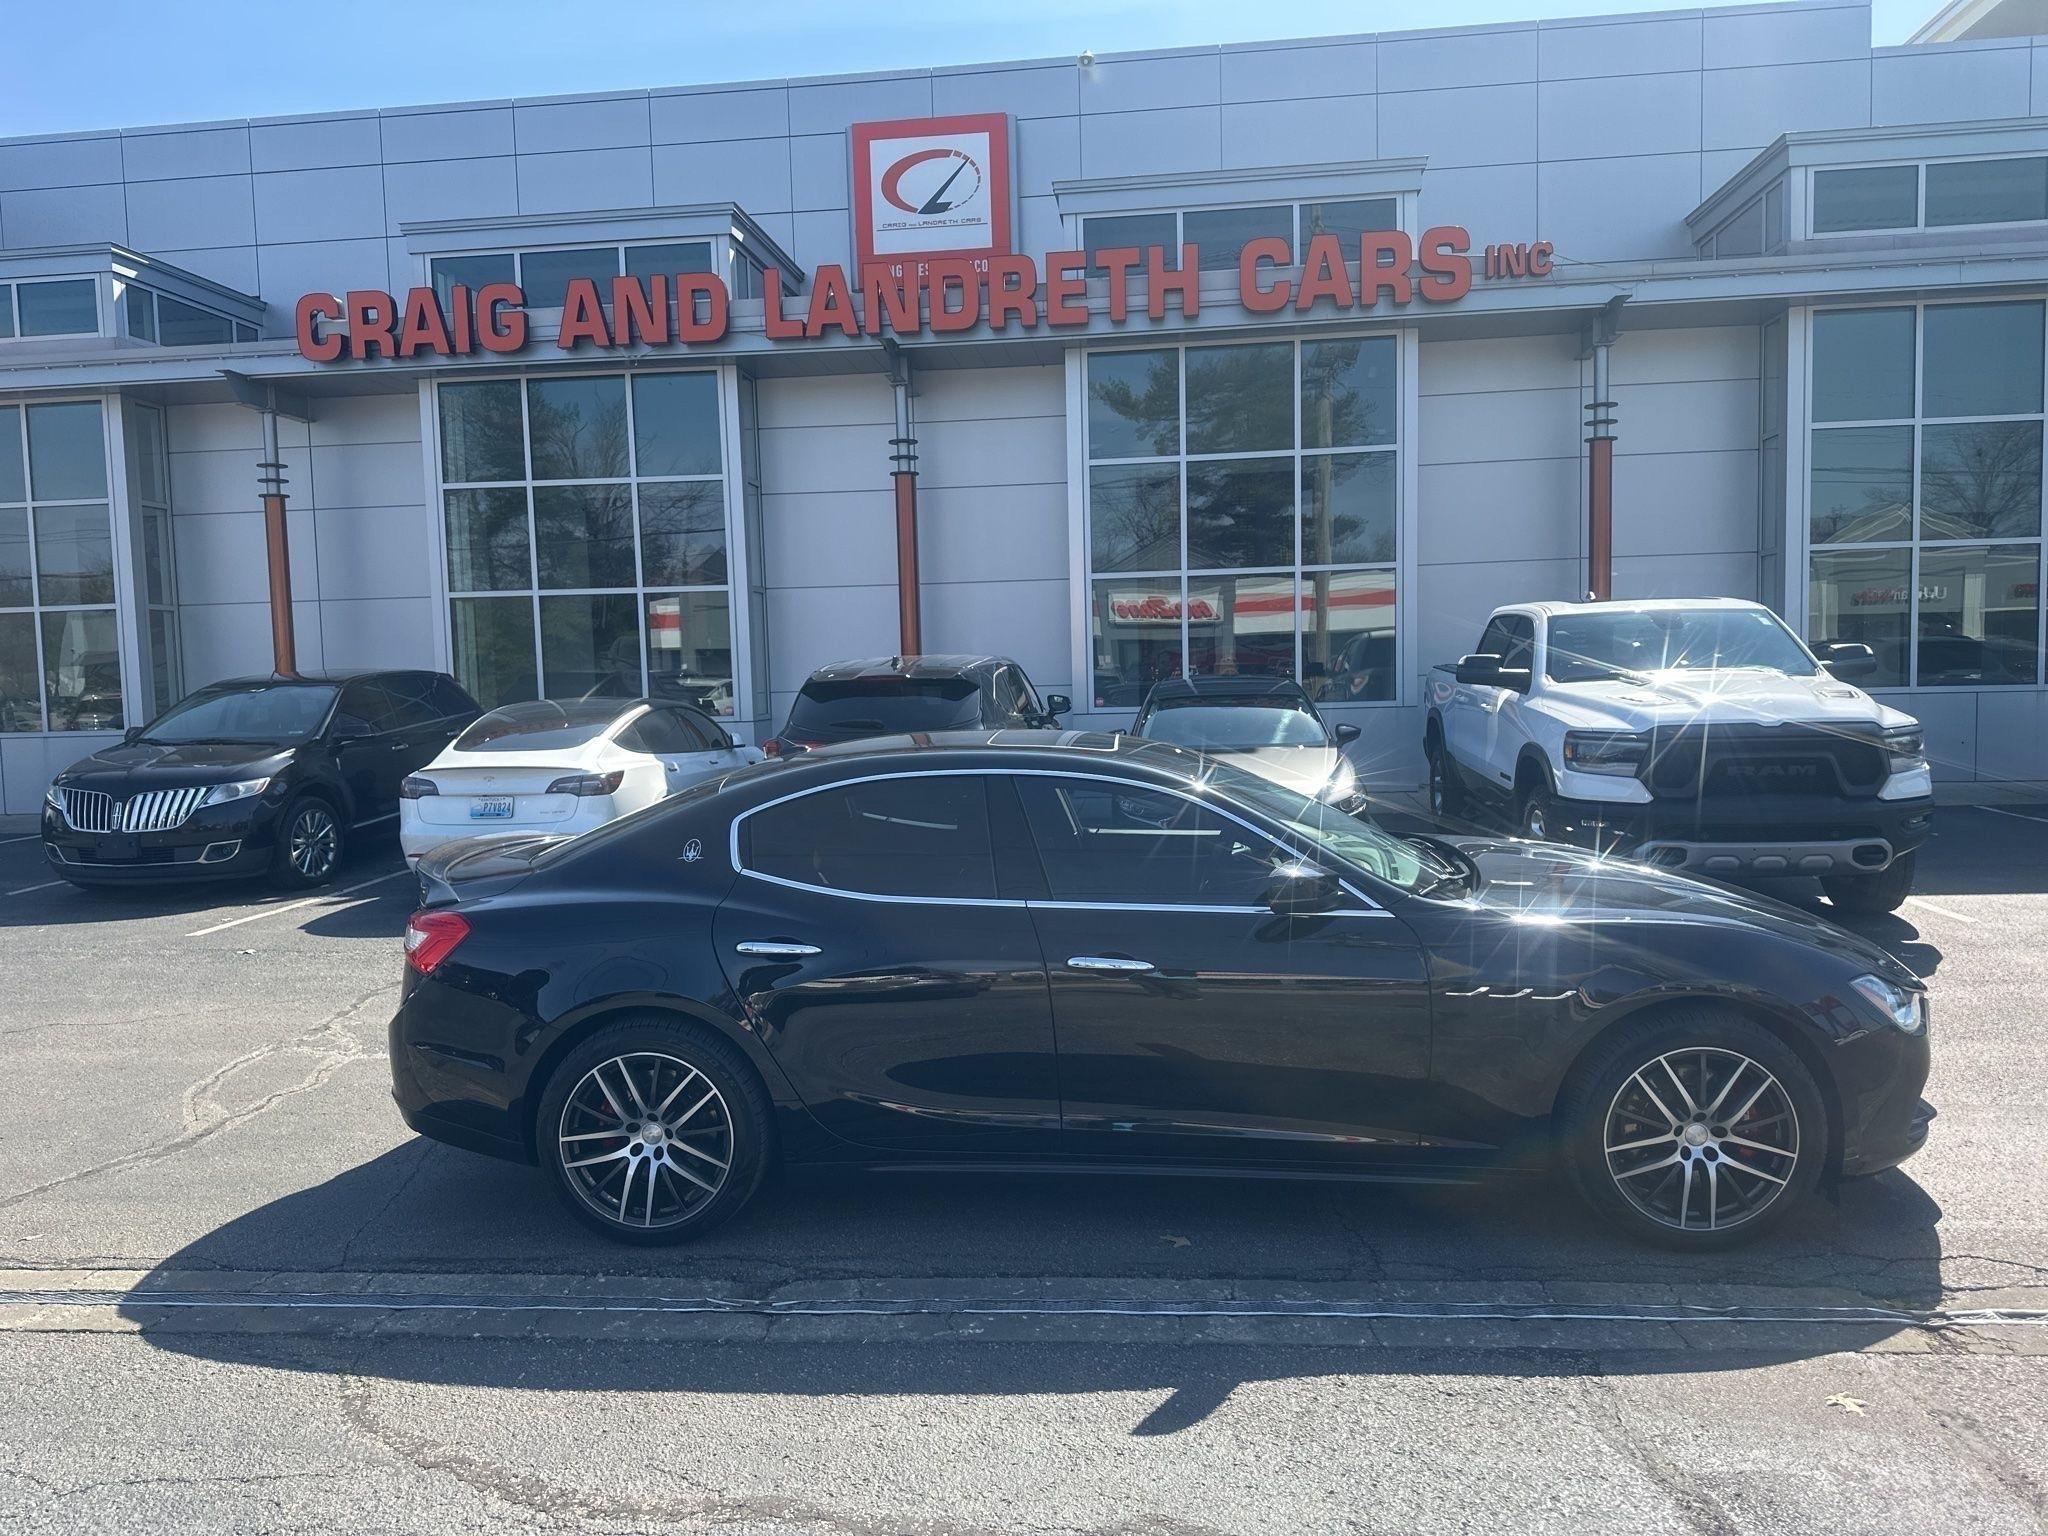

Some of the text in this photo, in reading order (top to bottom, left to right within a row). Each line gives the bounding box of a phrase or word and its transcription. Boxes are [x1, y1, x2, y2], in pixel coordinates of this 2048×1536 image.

[918, 218, 958, 227] LANDRETH
[297, 226, 1554, 362] CRAIG AND LANDRETH CARS INC
[1727, 765, 1817, 777] RAM
